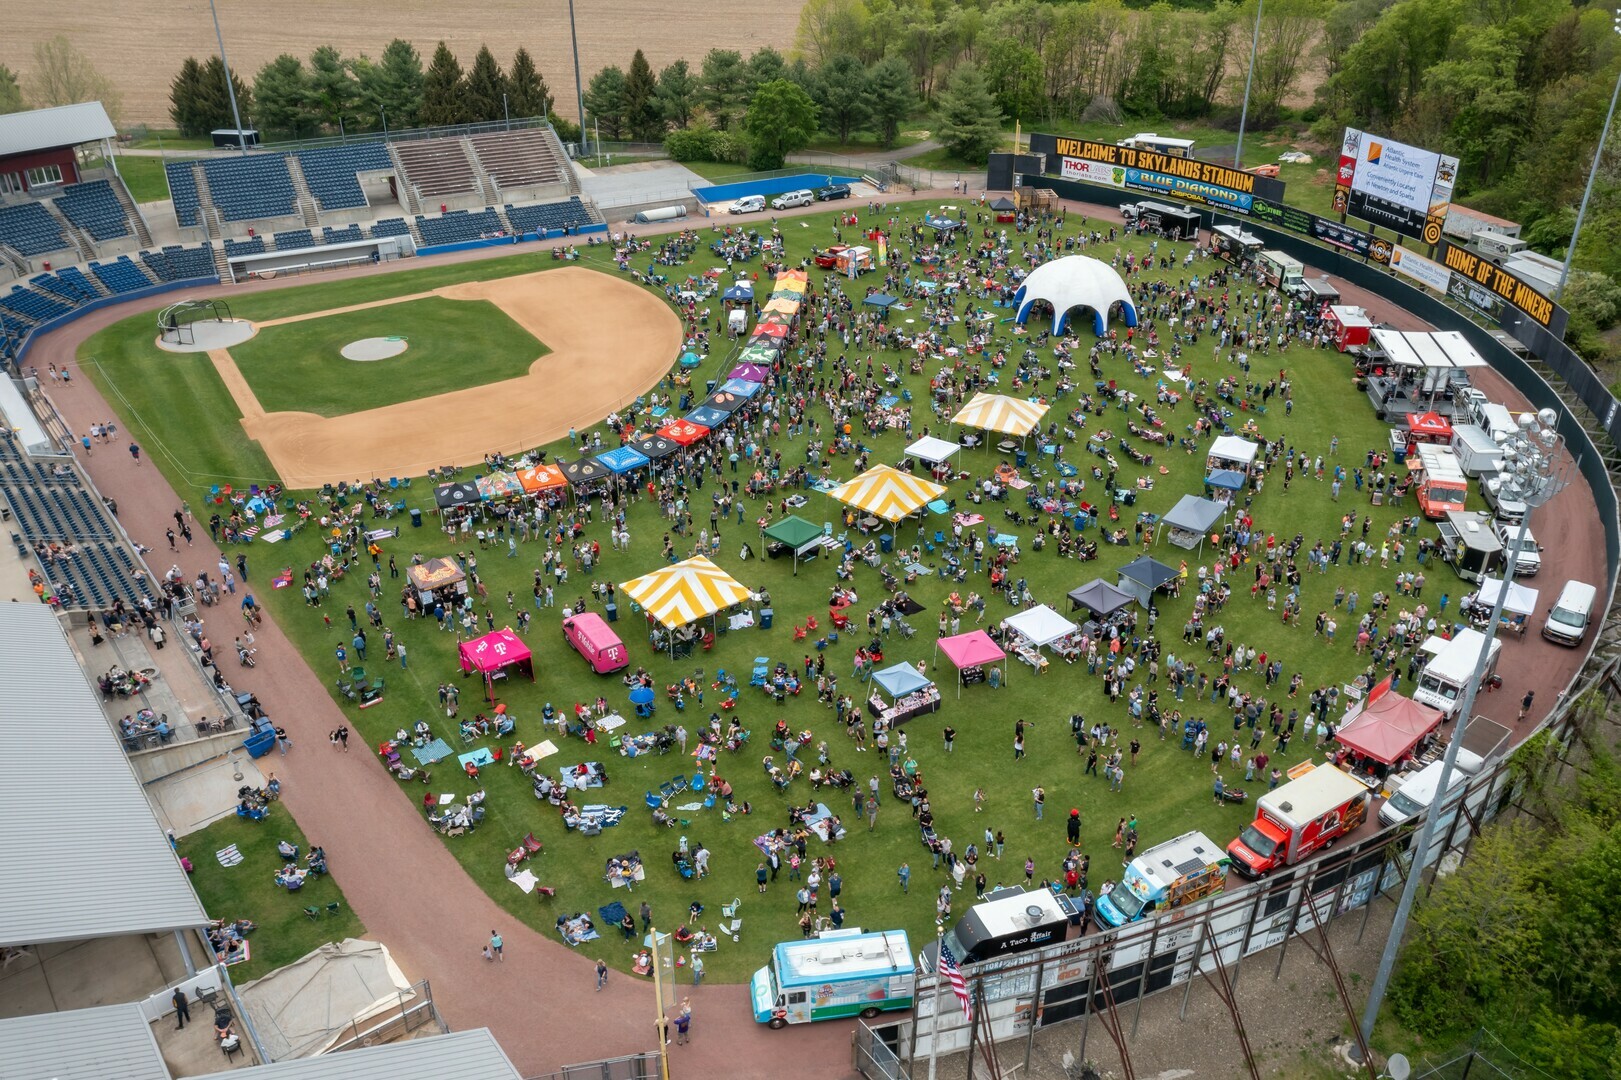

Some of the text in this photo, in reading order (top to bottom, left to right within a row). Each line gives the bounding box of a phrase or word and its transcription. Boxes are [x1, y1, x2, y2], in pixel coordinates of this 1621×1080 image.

[1386, 146, 1405, 157] Atlantic
[1056, 138, 1254, 192] WELCOME TO SKYLANDS STADIUM
[1384, 153, 1420, 169] Health System
[1066, 170, 1107, 181] thorlabs.com
[1383, 162, 1398, 172] Atlantic
[1399, 167, 1414, 177] Urgent
[1140, 173, 1238, 202] BLUE DIAMOND
[1367, 171, 1416, 192] Conveniently Located
[1171, 190, 1206, 202] DISPOSAL
[1371, 182, 1389, 193] Newton
[1389, 186, 1398, 195] and
[1399, 190, 1414, 201] Sparta
[1404, 255, 1448, 280] Atlantic Health System
[1445, 246, 1478, 277] HOME
[1476, 261, 1493, 284] OF
[1493, 270, 1516, 299] THE
[1513, 282, 1553, 326] MINERS
[494, 642, 506, 655] T
[581, 635, 595, 655] Mobile
[608, 647, 618, 660] T
[1418, 689, 1452, 705] HANDCRAFTED
[1010, 938, 1028, 946] Taco
